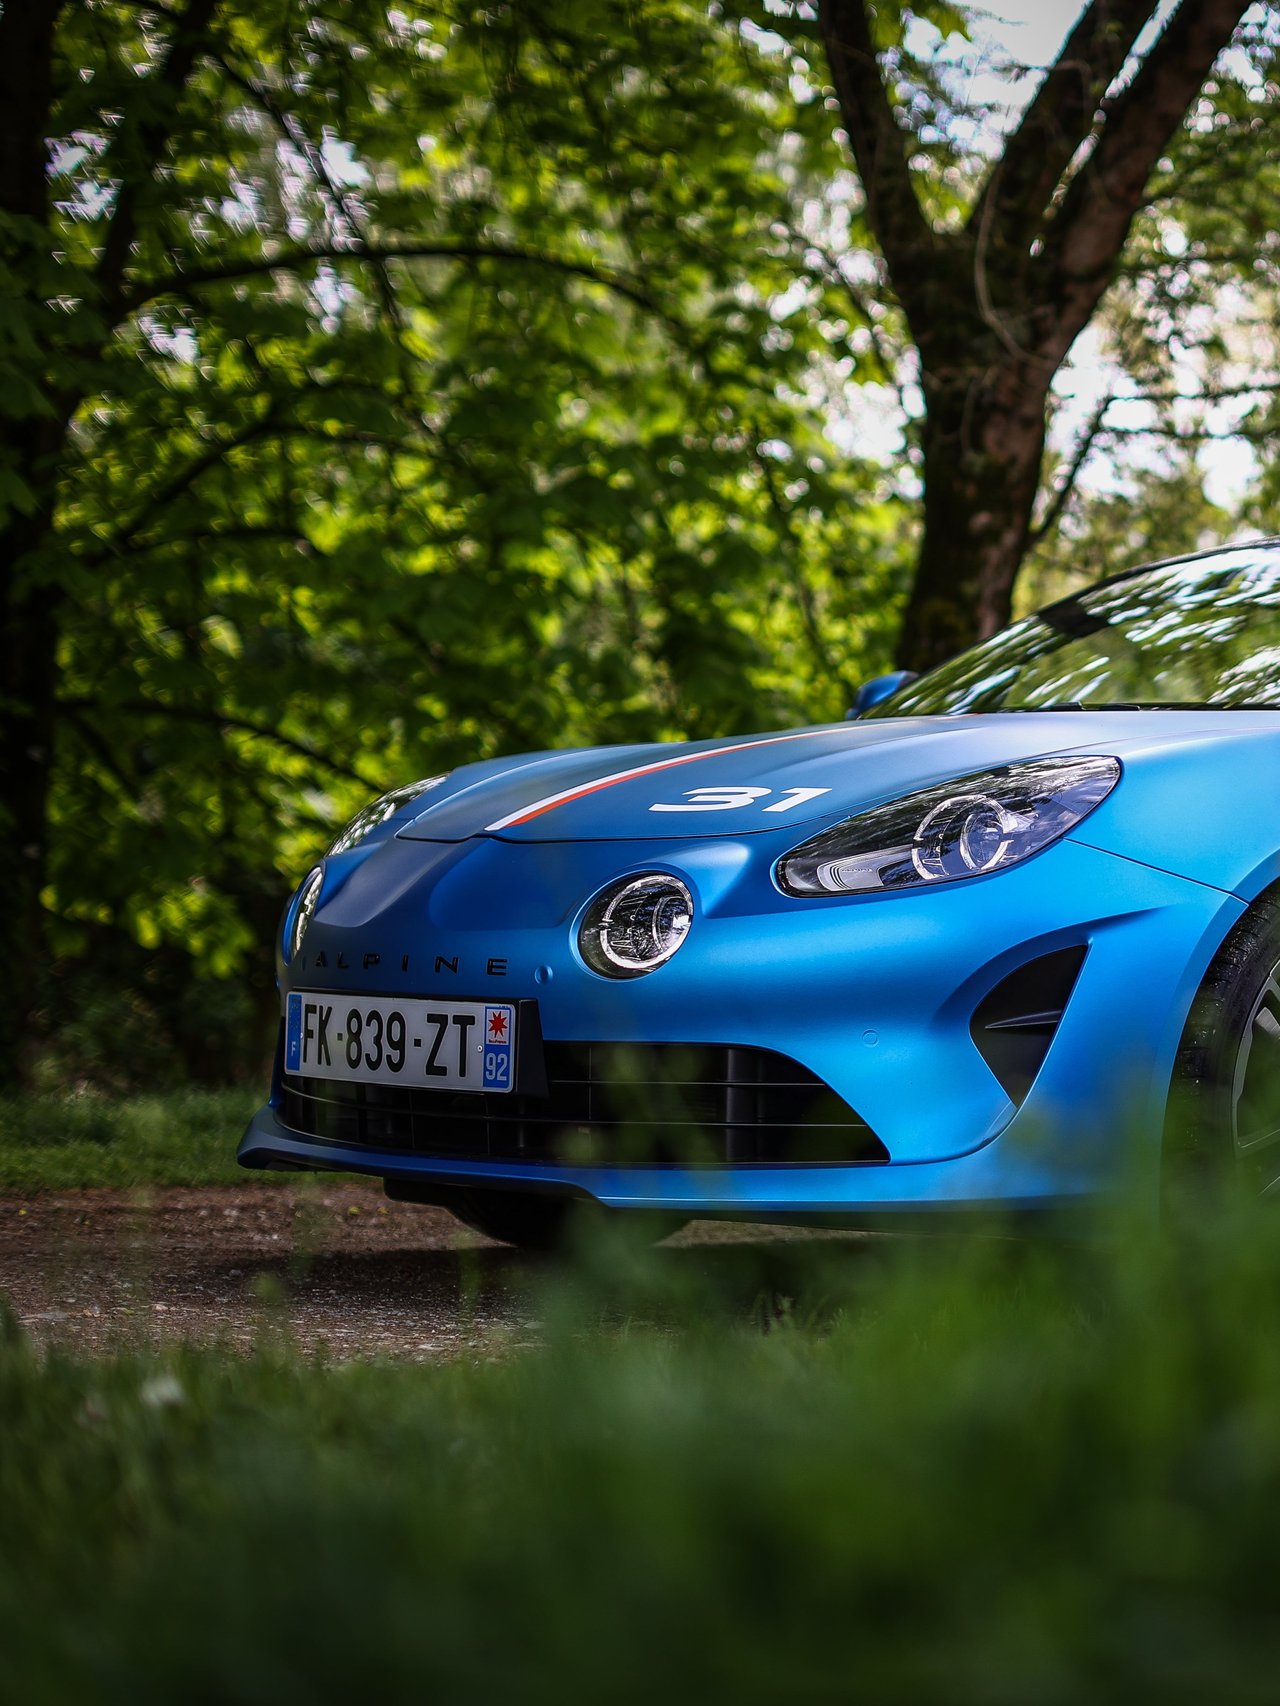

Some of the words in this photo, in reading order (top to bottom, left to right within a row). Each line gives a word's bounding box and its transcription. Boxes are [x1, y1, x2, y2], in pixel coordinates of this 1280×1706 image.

[648, 786, 833, 812] 31
[315, 952, 508, 977] ALPINE
[290, 1041, 297, 1057] F
[303, 1003, 476, 1078] FK-839-ZT
[485, 1052, 508, 1081] 92
